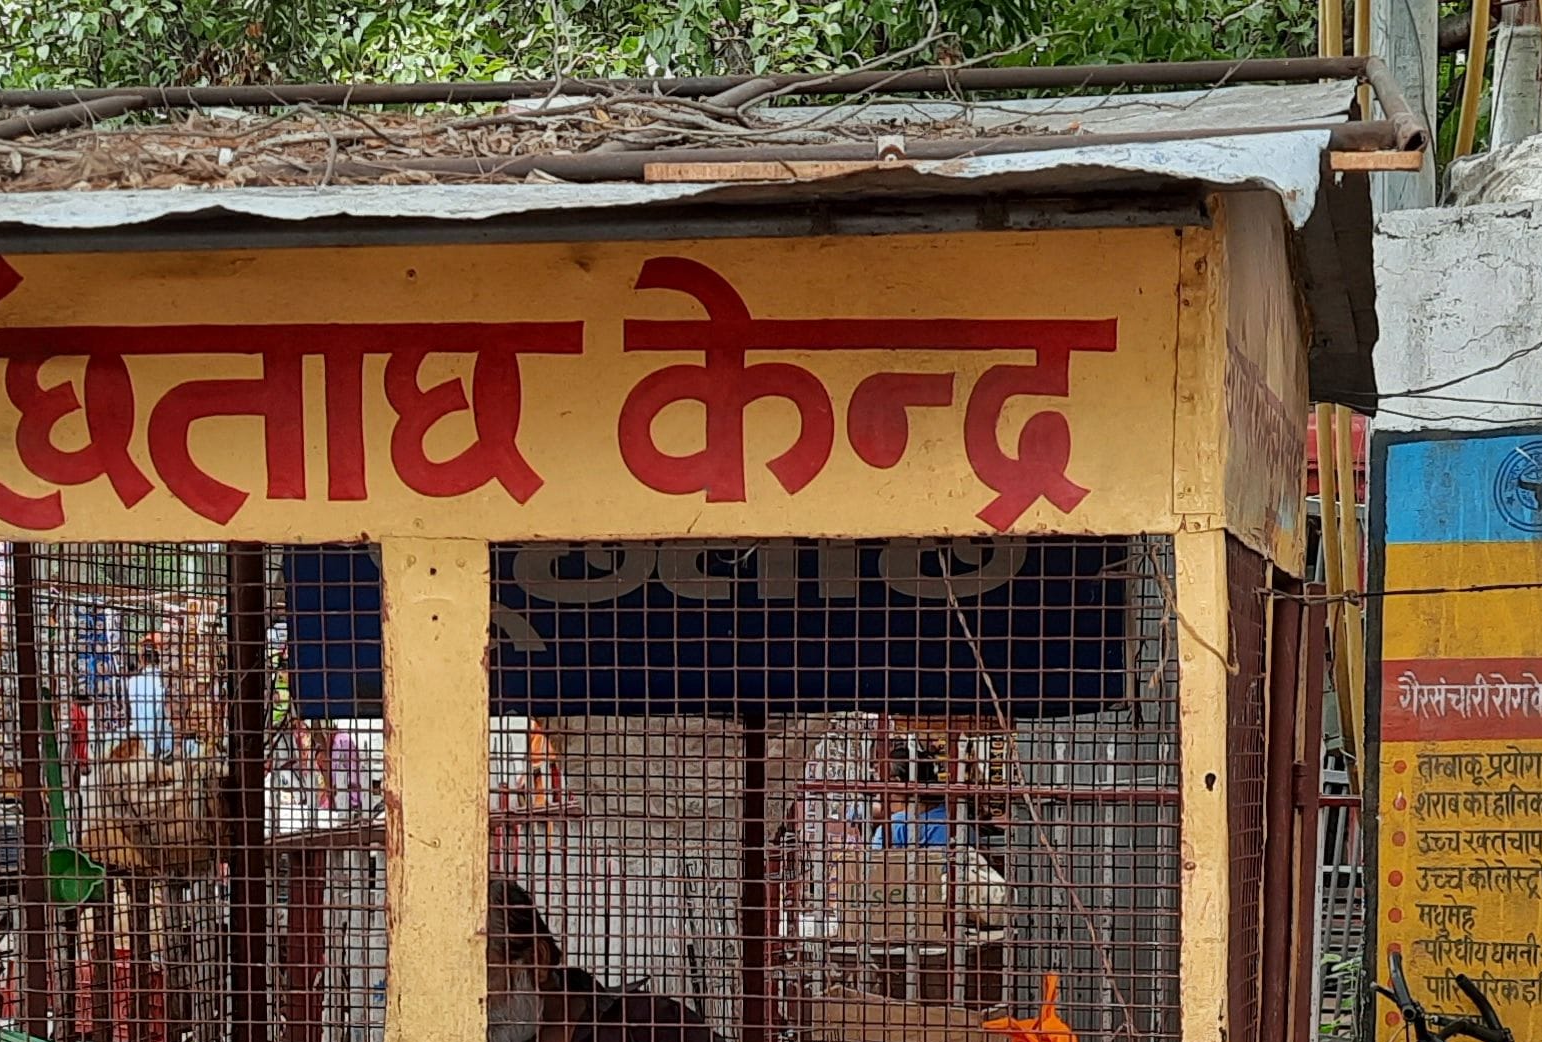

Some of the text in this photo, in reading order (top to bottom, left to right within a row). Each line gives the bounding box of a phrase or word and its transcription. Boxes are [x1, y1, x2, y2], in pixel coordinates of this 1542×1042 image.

[616, 254, 1120, 534] केन्द्र
[1415, 752, 1488, 787] तम्बाकू
[1413, 790, 1462, 822] शराब
[1462, 790, 1494, 818] का
[1416, 830, 1462, 856] उच्च
[1416, 866, 1469, 893] उच्च
[1414, 894, 1477, 938] मधुमेह
